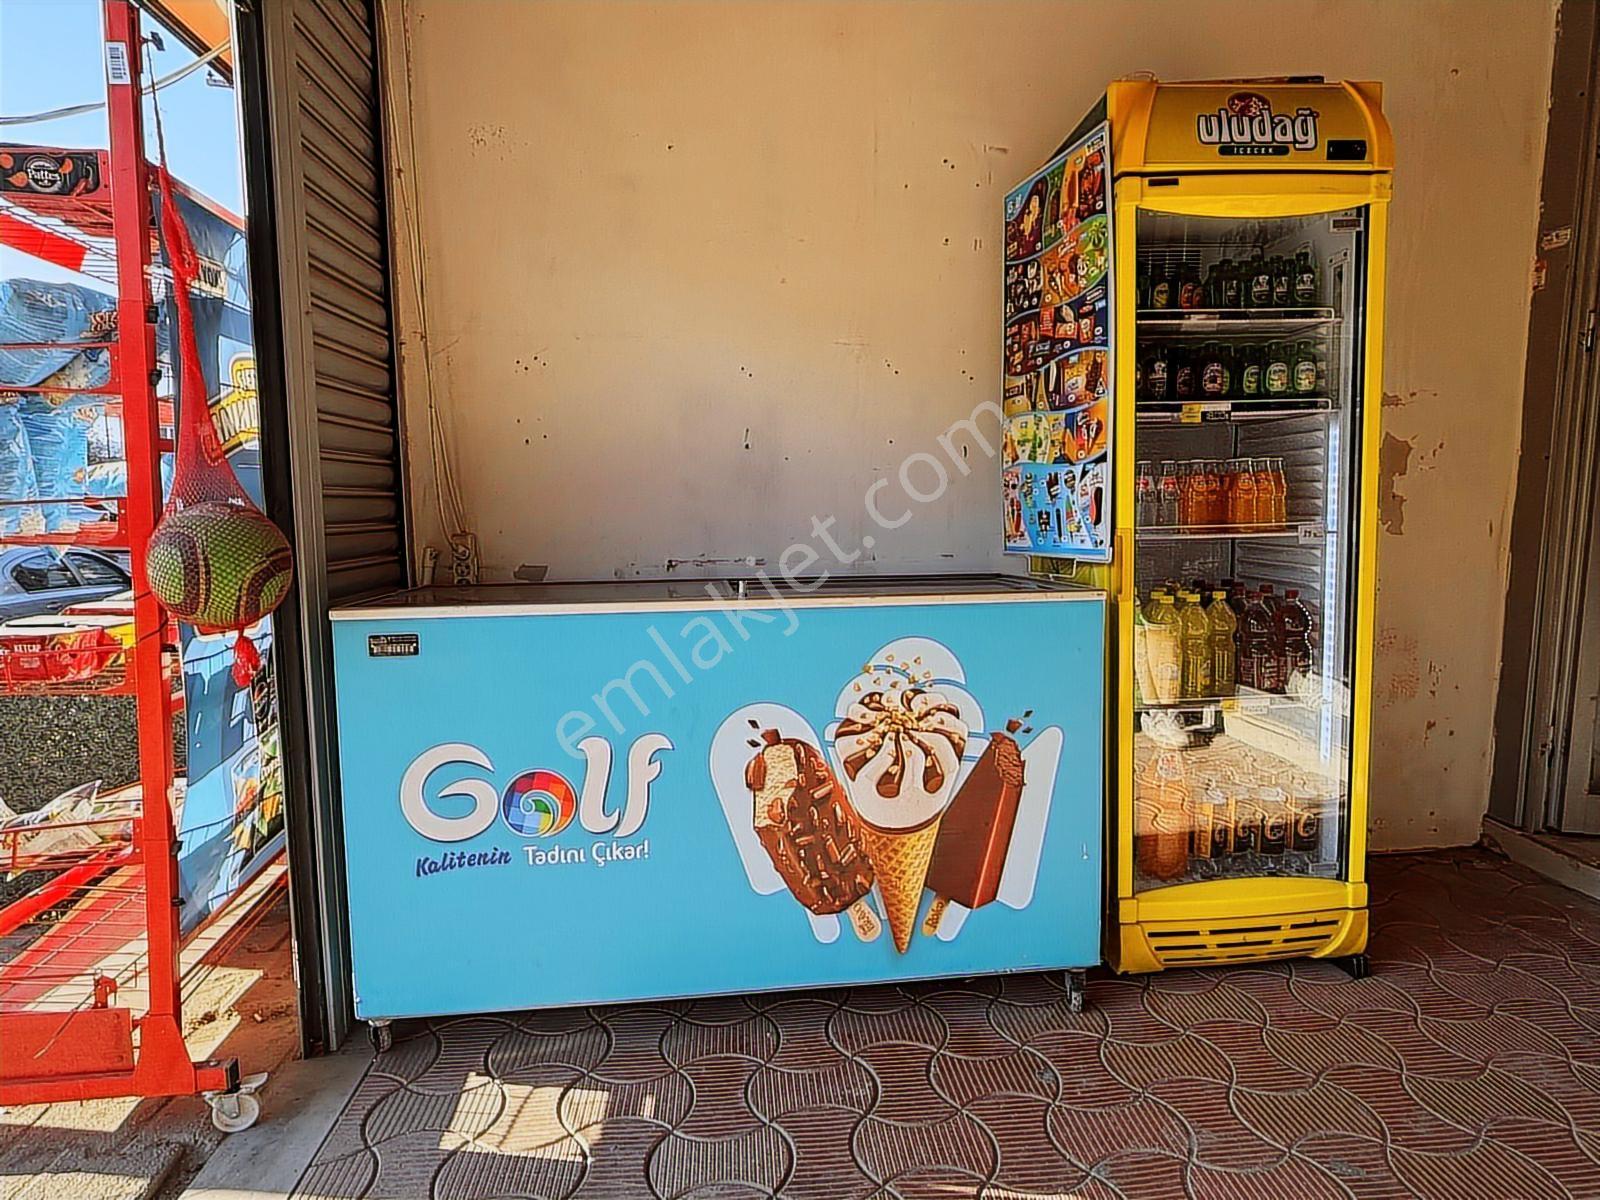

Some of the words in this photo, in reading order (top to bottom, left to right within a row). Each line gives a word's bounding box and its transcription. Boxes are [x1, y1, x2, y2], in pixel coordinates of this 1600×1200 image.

[400, 733, 675, 842] Golf
[415, 847, 512, 878] Kalitenin
[523, 844, 586, 866] Tadını
[591, 839, 650, 867] Çıkar!
